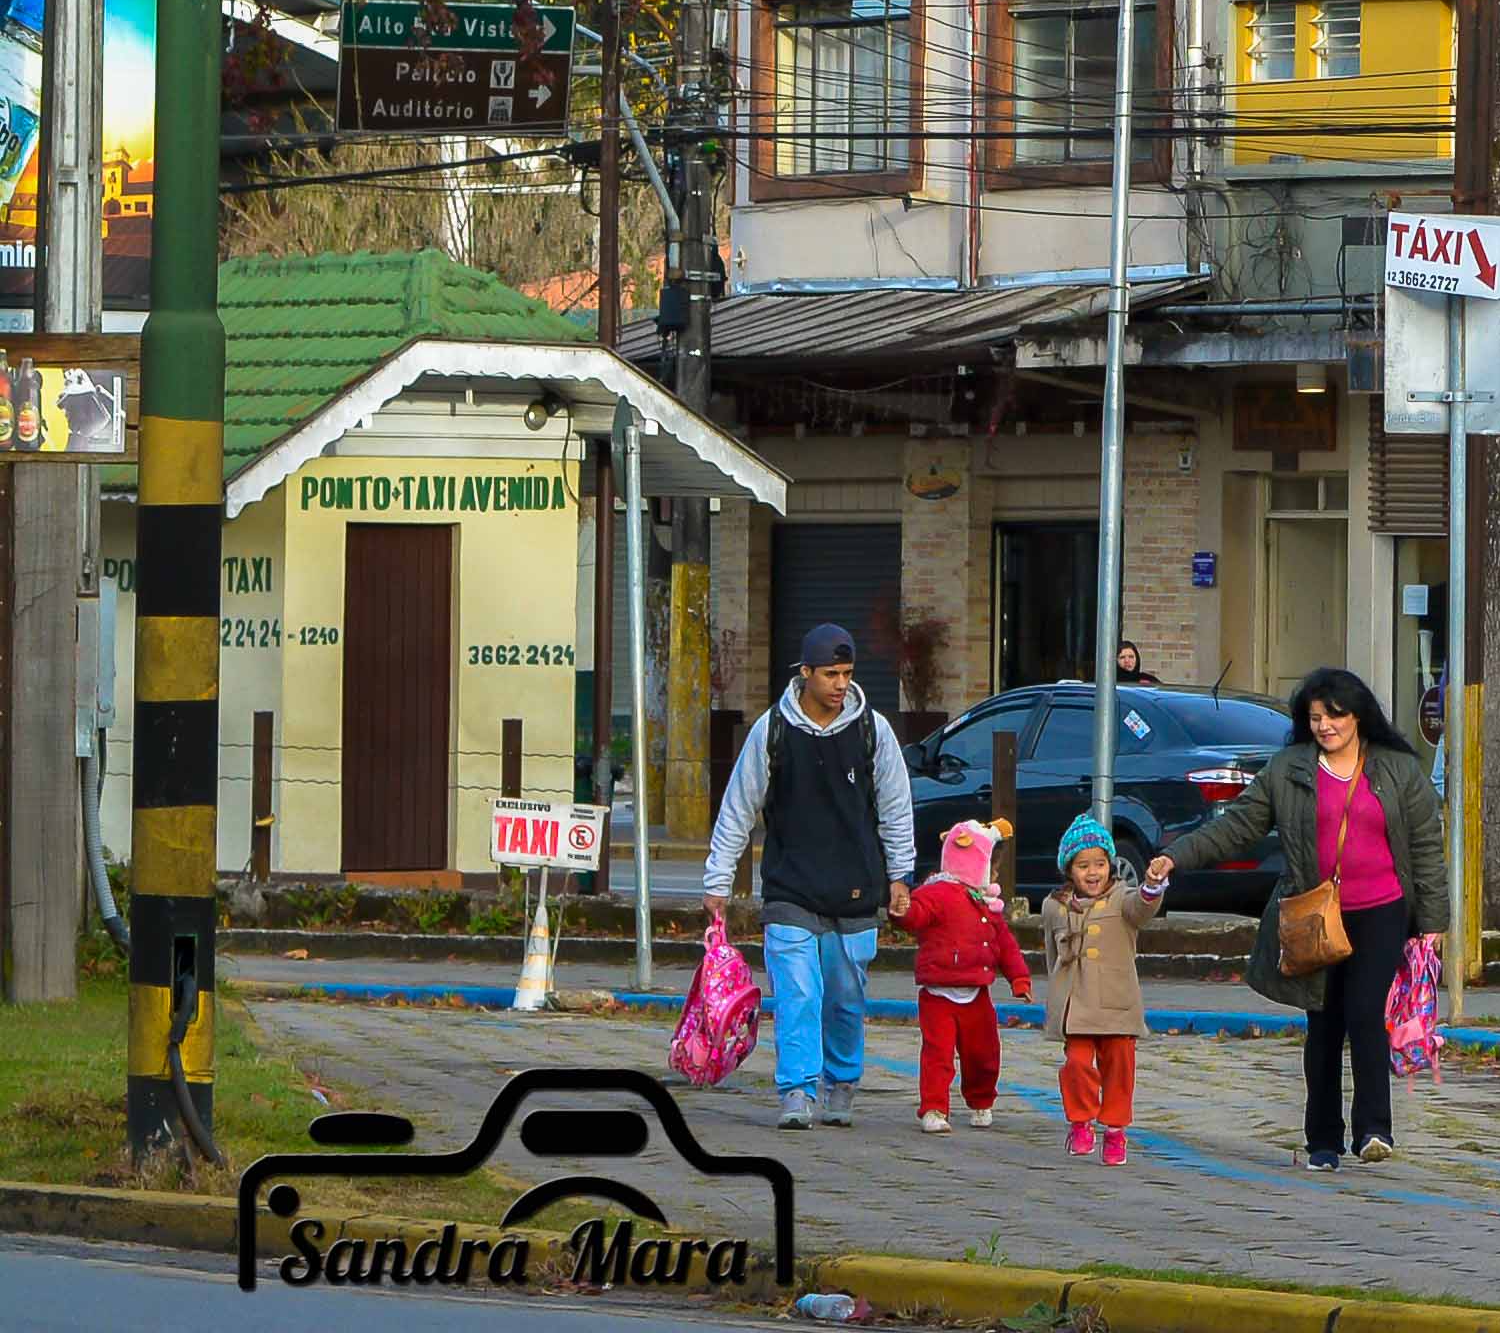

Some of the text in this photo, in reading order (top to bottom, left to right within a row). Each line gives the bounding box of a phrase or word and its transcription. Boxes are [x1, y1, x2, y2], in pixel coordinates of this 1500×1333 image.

[358, 13, 405, 36] Alto
[371, 97, 475, 121] Auditório
[1390, 218, 1464, 266] TÁXI
[1387, 270, 1460, 293] 12 3662-2727
[458, 475, 566, 512] AVENIDA
[222, 556, 273, 594] TAXI
[495, 799, 552, 813] EXCLUSIVO
[495, 815, 560, 859] TAXI
